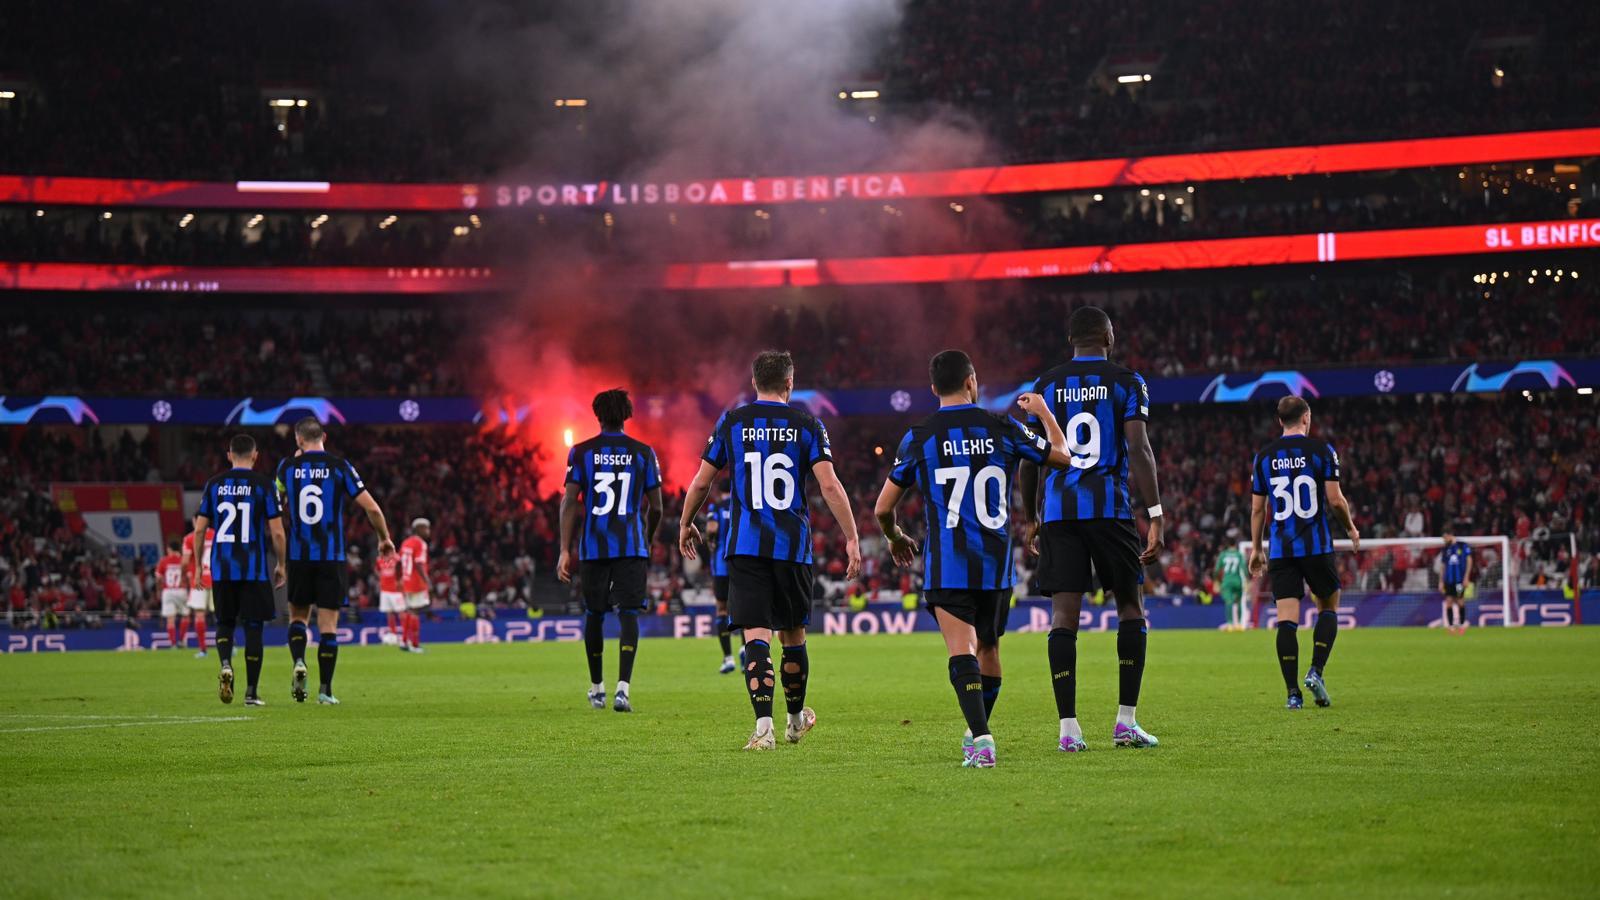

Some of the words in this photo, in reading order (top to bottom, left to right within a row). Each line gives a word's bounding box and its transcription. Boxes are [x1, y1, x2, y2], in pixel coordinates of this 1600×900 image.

[496, 183, 598, 207] SPORT
[612, 181, 727, 204] LISBOA
[773, 176, 906, 201] BENFICA
[1485, 228, 1513, 248] SL
[1056, 386, 1107, 403] THURAM
[742, 428, 798, 443] FRATTESI
[943, 438, 995, 456] ALEXIS
[1065, 412, 1101, 469] 9
[594, 453, 632, 466] BISSECK
[1272, 456, 1306, 470] CARLOS
[295, 468, 307, 479] DE
[309, 468, 330, 479] VRIJ
[744, 451, 796, 511] 16
[218, 485, 252, 496] ASLLANI
[592, 472, 631, 516] 31
[934, 465, 1008, 530] 70
[1269, 475, 1318, 521] 30
[299, 484, 324, 525] 6
[216, 502, 251, 543] 21
[673, 615, 713, 638] FE
[824, 611, 918, 635] NOW
[1478, 604, 1572, 627] PS5
[505, 620, 582, 641] PS5
